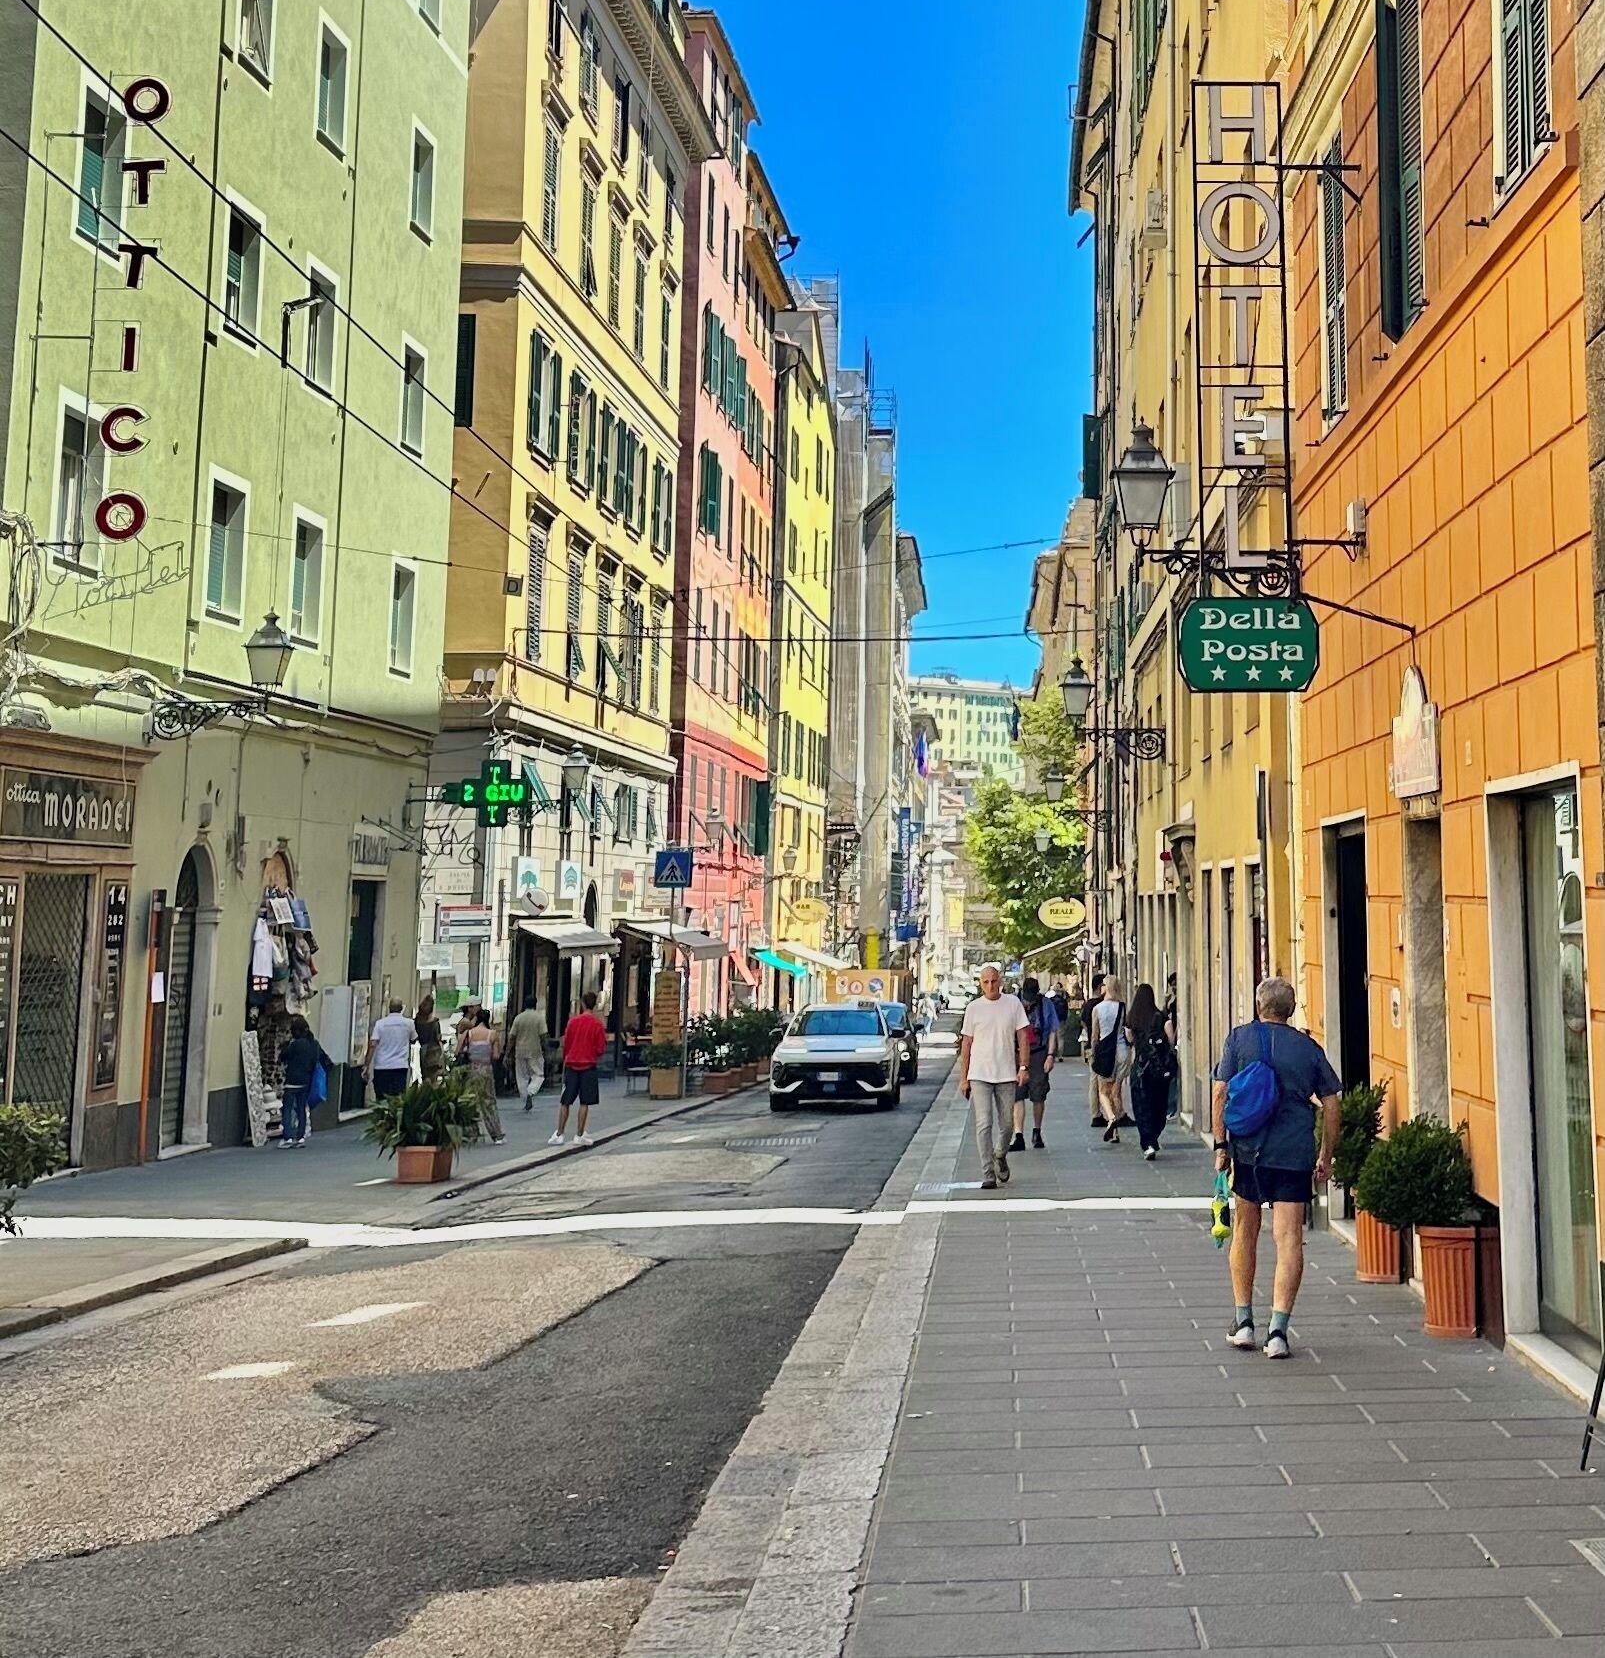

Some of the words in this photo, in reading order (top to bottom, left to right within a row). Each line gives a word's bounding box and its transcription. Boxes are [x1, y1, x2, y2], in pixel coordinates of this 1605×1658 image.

[94, 76, 173, 542] OTTICO
[1199, 85, 1281, 569] HOTEL
[1199, 607, 1301, 630] Della
[1201, 639, 1304, 661] Posta
[463, 784, 475, 801] 2
[486, 784, 524, 802] GIU
[6, 782, 41, 804] ottica
[44, 792, 131, 832] MORADEI
[108, 885, 126, 905] 14
